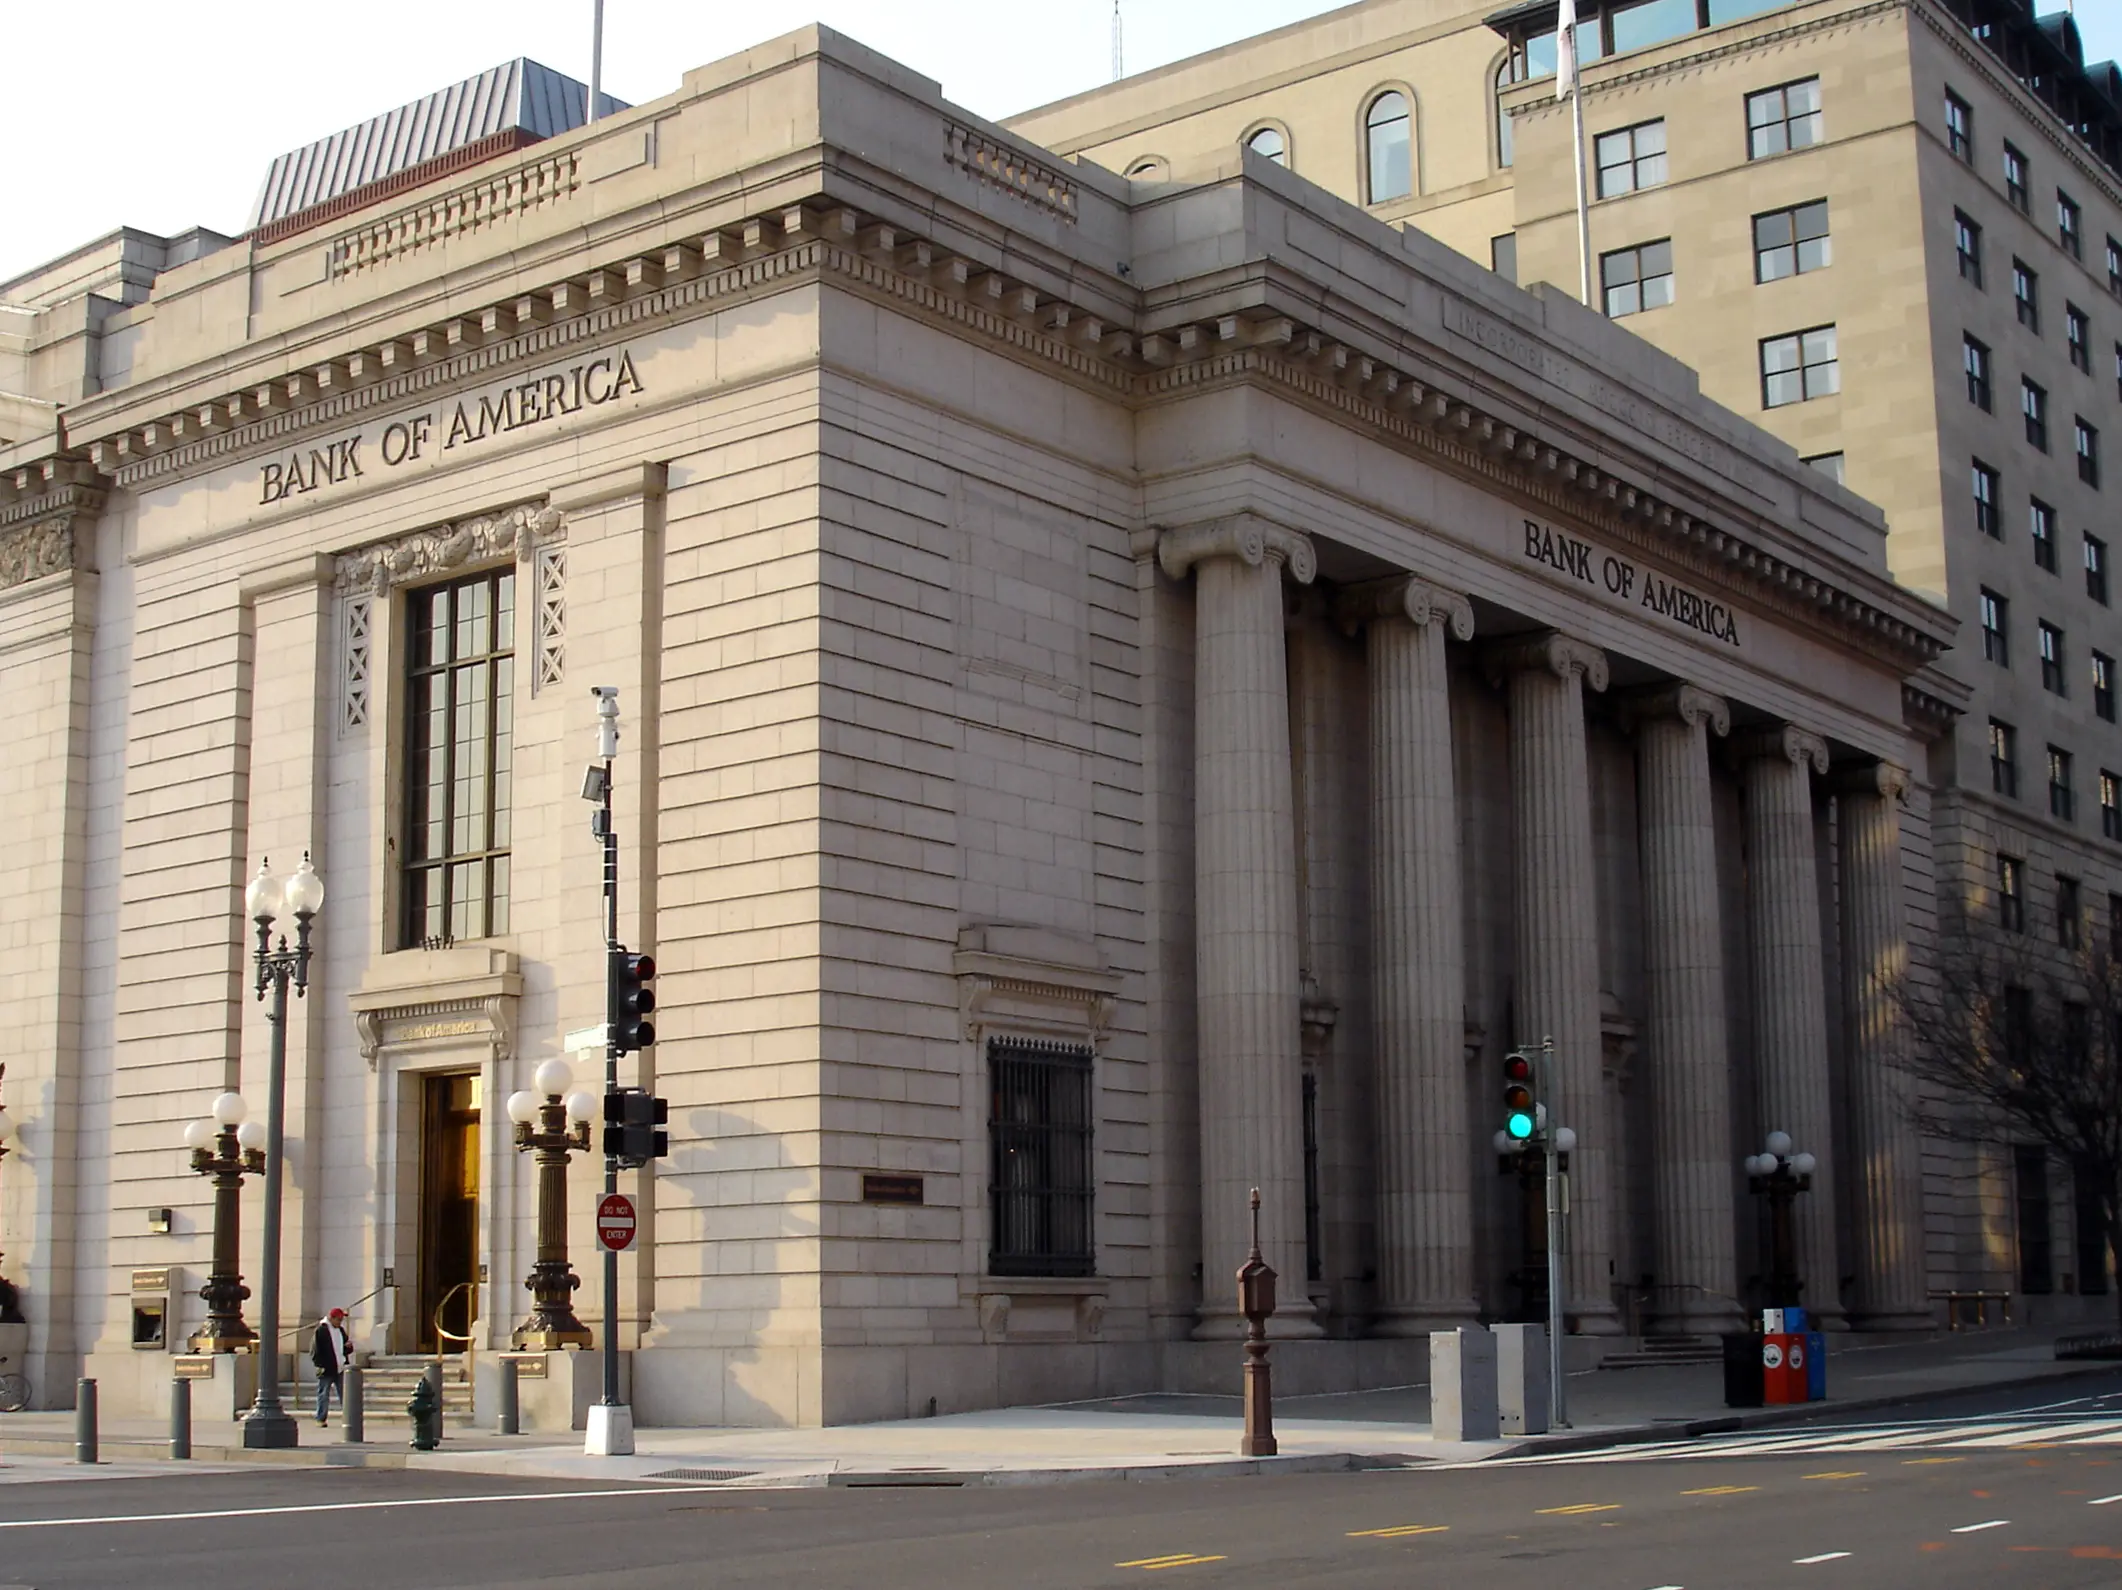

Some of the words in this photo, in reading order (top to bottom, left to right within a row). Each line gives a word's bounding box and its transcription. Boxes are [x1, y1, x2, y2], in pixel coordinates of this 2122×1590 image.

[259, 434, 364, 505] BANK
[381, 413, 432, 466] OF
[444, 349, 644, 449] AMERICA
[1523, 519, 1595, 584] BANK
[1603, 557, 1634, 599] OF
[1641, 572, 1741, 647] AMERICA
[435, 1020, 477, 1037] America
[604, 1206, 613, 1215] DO
[616, 1206, 628, 1215] NOT
[606, 1230, 627, 1239] ENTER
